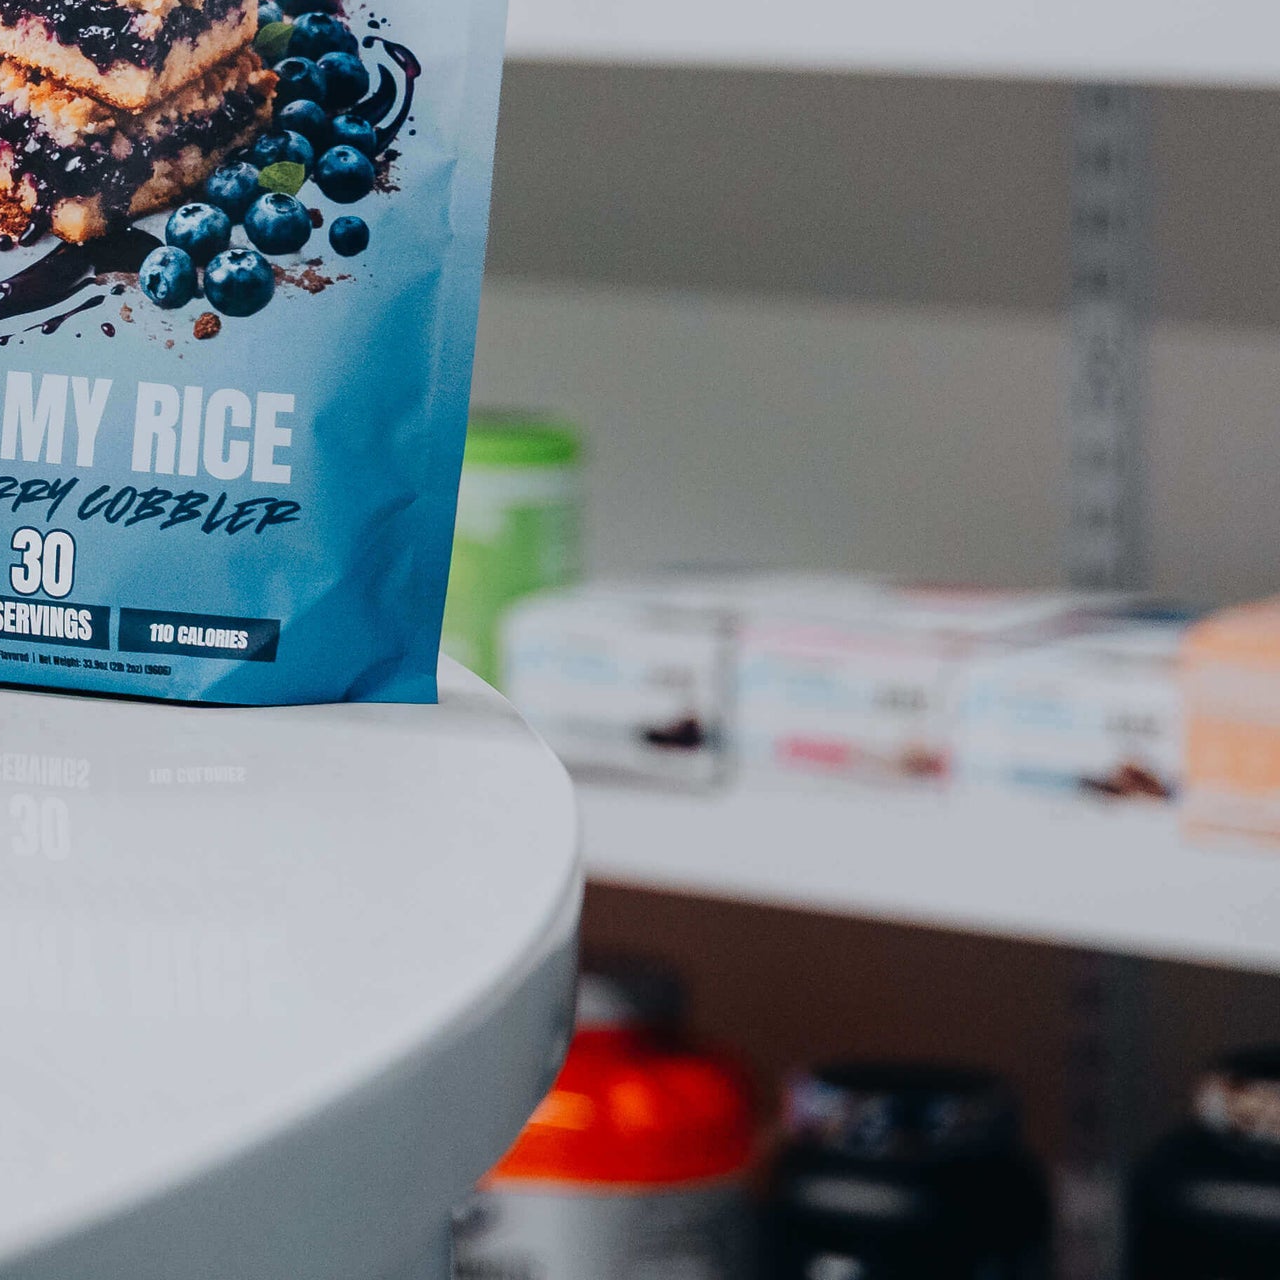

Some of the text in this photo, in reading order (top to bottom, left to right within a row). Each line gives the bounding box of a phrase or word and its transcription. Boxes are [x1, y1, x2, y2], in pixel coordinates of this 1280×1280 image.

[131, 381, 296, 485] RICE
[78, 484, 302, 537] COBBLER
[10, 527, 75, 597] 30
[53, 655, 81, 668] Weight:
[150, 623, 248, 649] 110 CALORIES
